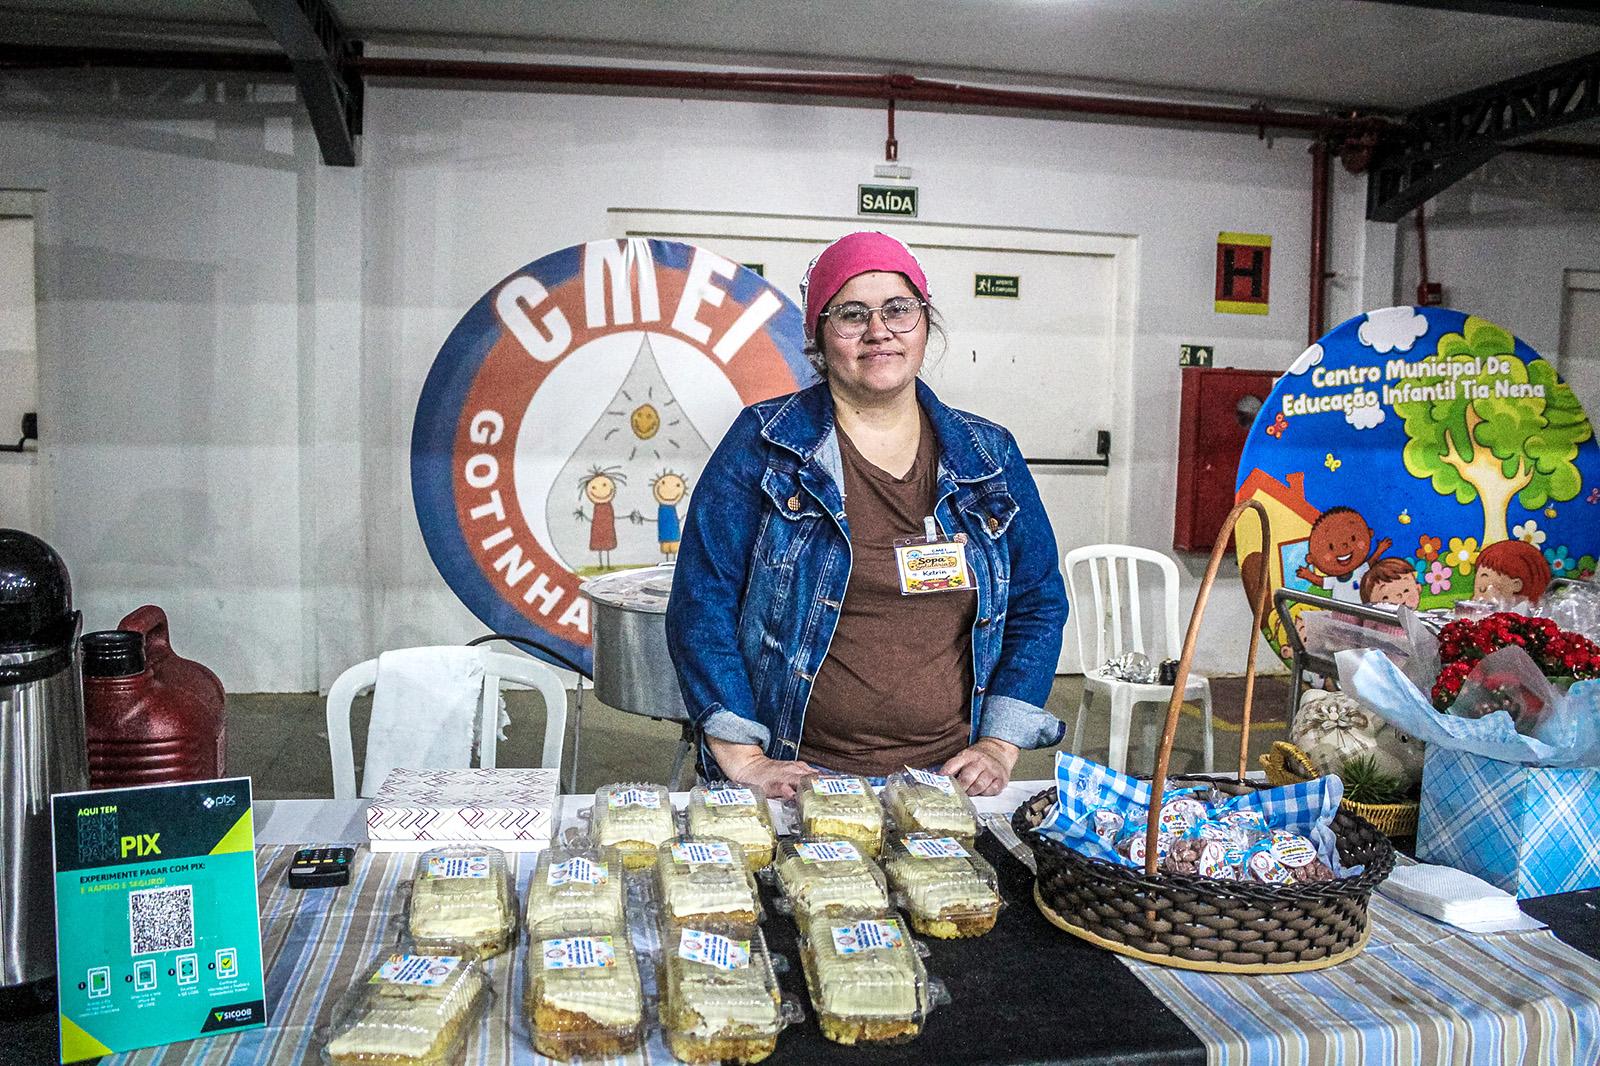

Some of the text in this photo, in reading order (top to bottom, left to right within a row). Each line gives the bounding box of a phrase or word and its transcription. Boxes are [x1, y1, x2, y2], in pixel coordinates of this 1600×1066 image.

[862, 191, 913, 212] SAÍDA
[1223, 249, 1264, 297] H
[495, 237, 783, 363] CMEI
[1312, 356, 1511, 388] Centro Municipal De
[1281, 380, 1545, 417] Educação Infantil Tia Nena
[918, 556, 946, 566] Sopa
[78, 805, 118, 817] AQUI TEM
[121, 833, 161, 859] PIX
[80, 870, 138, 884] EXPERIMENTE
[140, 867, 168, 877] PAGAR
[169, 864, 189, 873] COM
[224, 1008, 252, 1020] SICOOB
